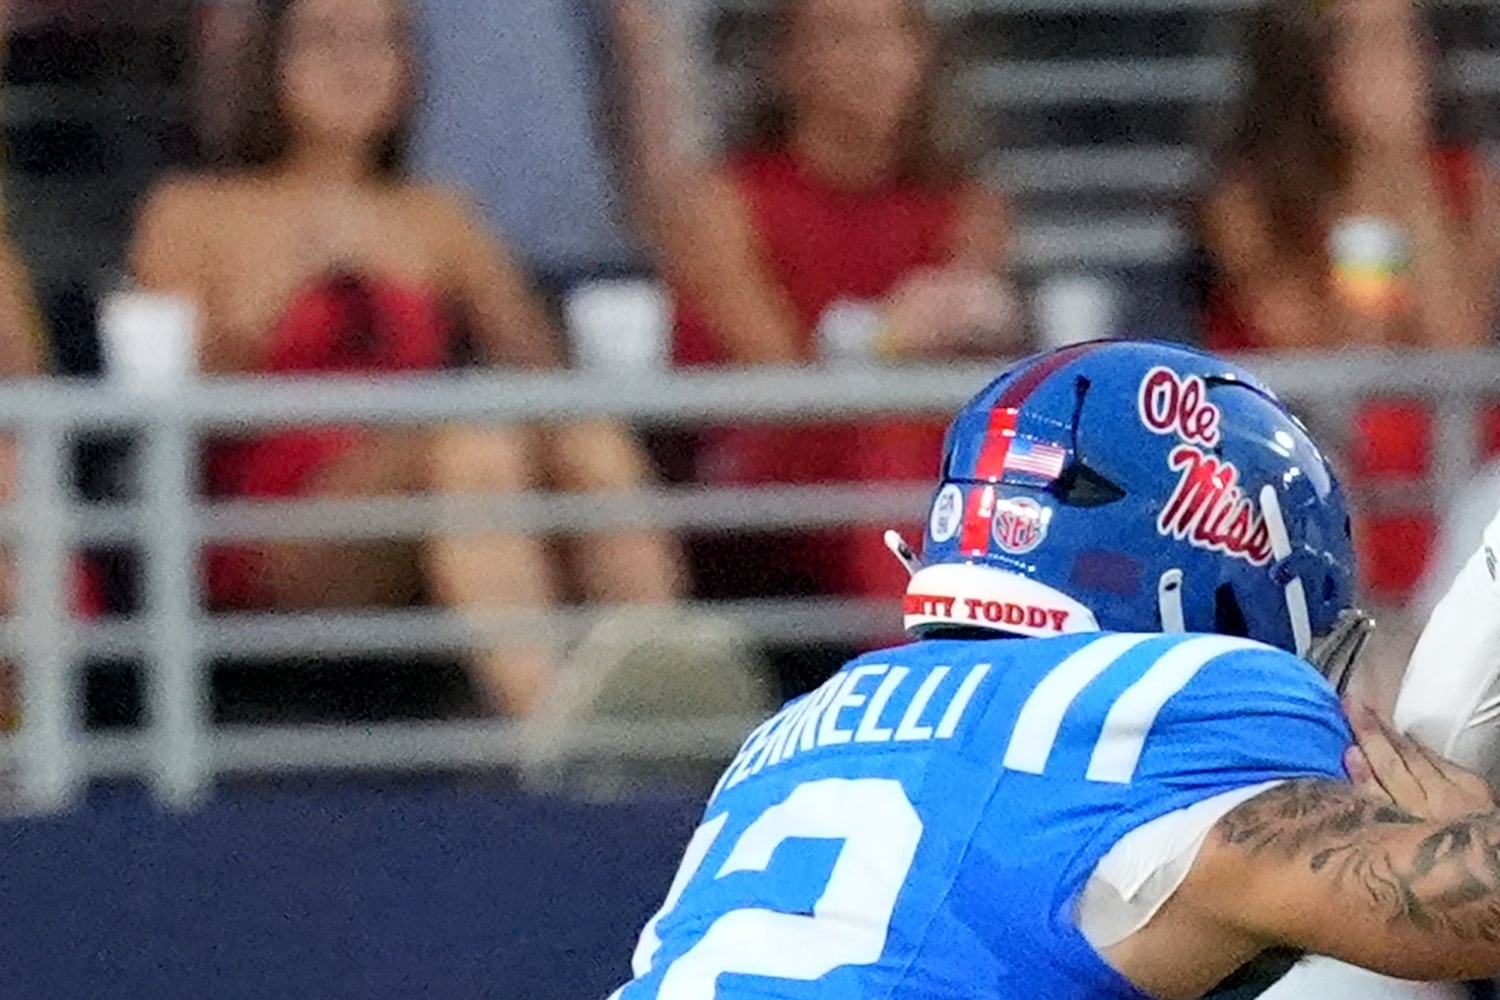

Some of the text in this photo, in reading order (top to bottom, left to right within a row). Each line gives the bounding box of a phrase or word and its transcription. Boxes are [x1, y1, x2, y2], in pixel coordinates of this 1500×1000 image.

[1140, 367, 1220, 447] Ole
[1158, 446, 1273, 565] Miss
[964, 598, 1069, 631] TODDY
